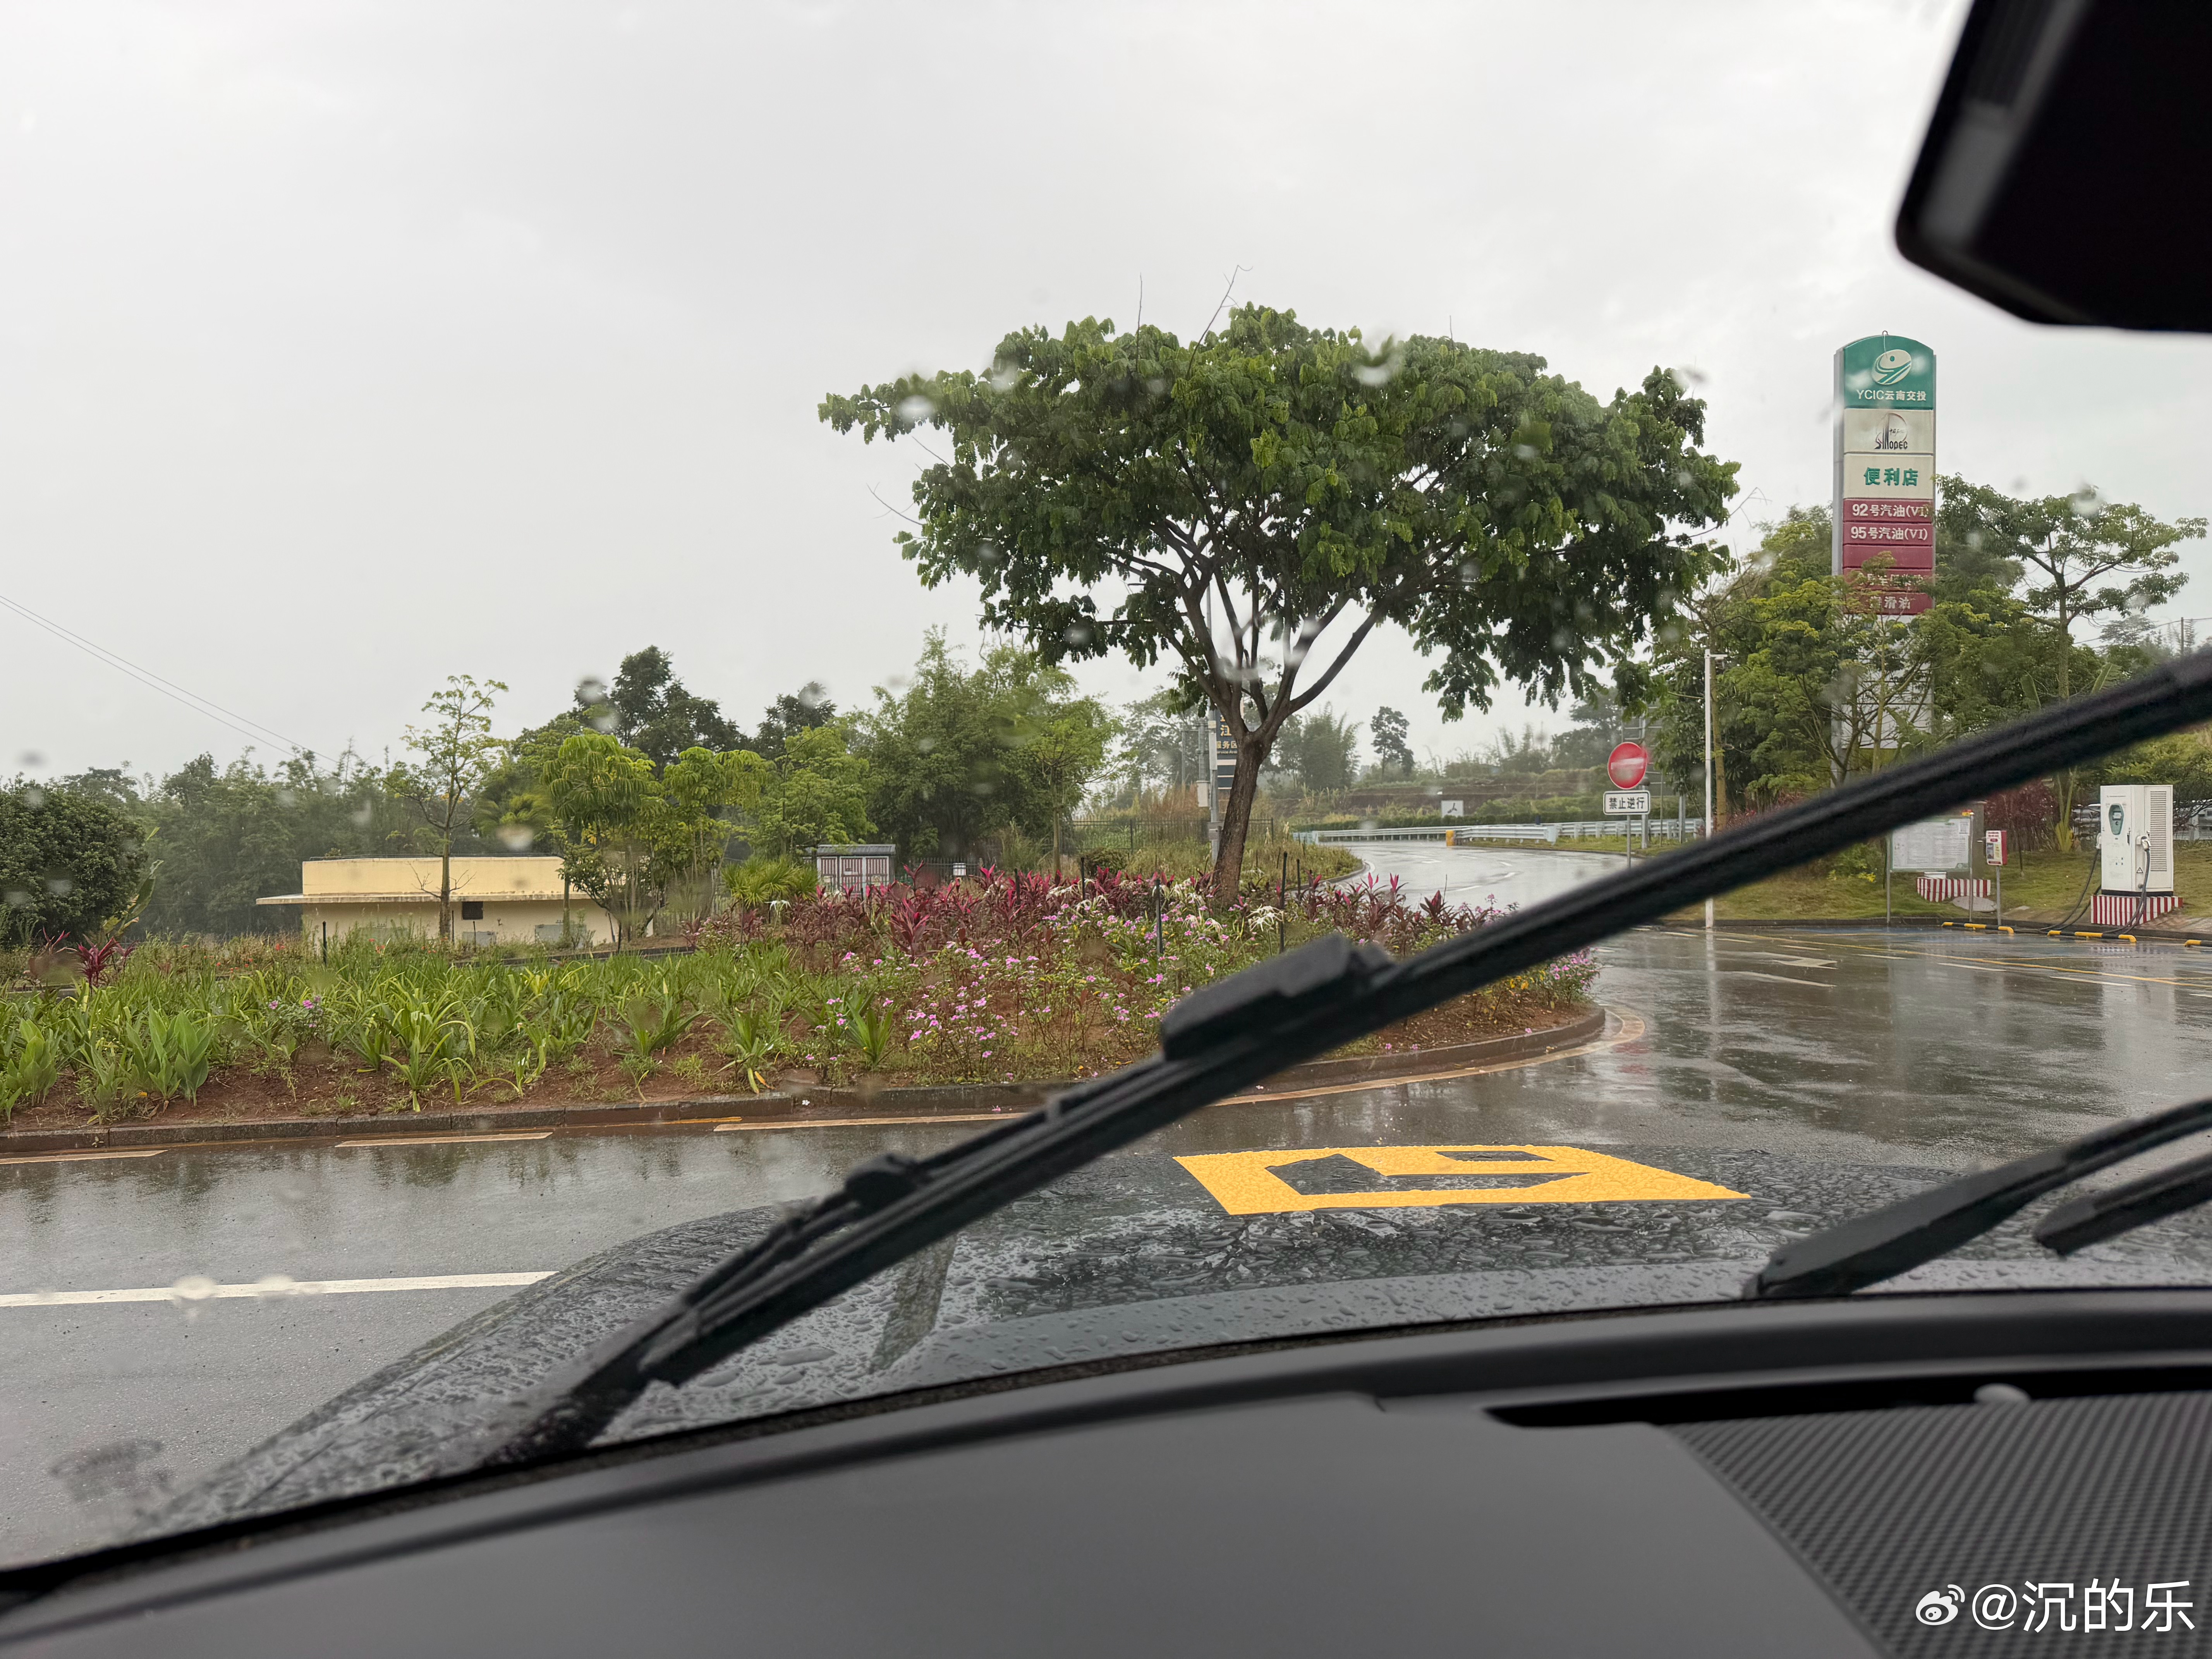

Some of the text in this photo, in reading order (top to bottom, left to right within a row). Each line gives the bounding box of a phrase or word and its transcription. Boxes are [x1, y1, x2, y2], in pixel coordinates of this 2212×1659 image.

[1863, 467, 1918, 486] 便利店
[1851, 526, 1928, 540] 95号汽油(VI)
[1609, 797, 1645, 809] 禁止逆行
